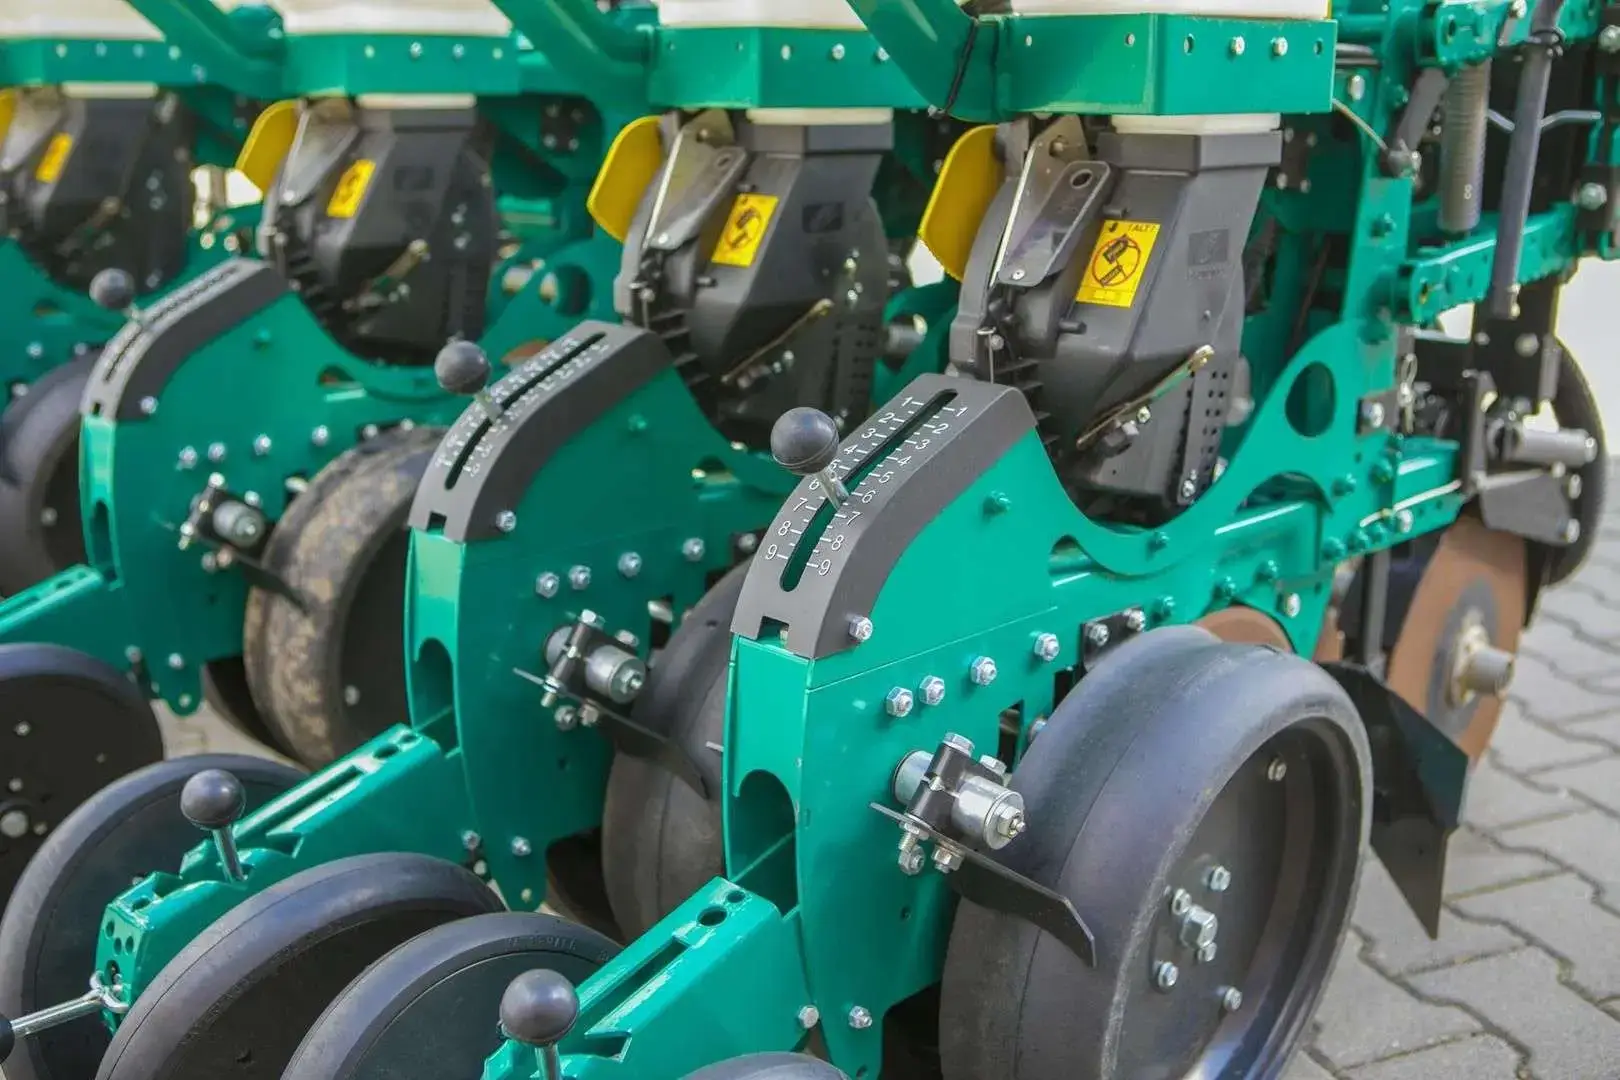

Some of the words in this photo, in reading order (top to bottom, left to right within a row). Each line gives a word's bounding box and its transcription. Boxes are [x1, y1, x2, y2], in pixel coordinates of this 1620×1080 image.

[901, 396, 913, 407] 1
[878, 412, 895, 423] 2
[956, 407, 968, 417] 1
[861, 428, 876, 438] 3
[932, 423, 949, 434] 2
[843, 444, 858, 455] 4
[915, 439, 930, 449] 3
[897, 456, 912, 467] 4
[878, 471, 894, 483] 5
[862, 490, 876, 503] 6
[793, 497, 808, 511] 7
[846, 511, 862, 525] 7
[778, 520, 791, 536] 8
[831, 535, 844, 551] 8
[765, 544, 777, 560] 9
[818, 559, 831, 576] 9
